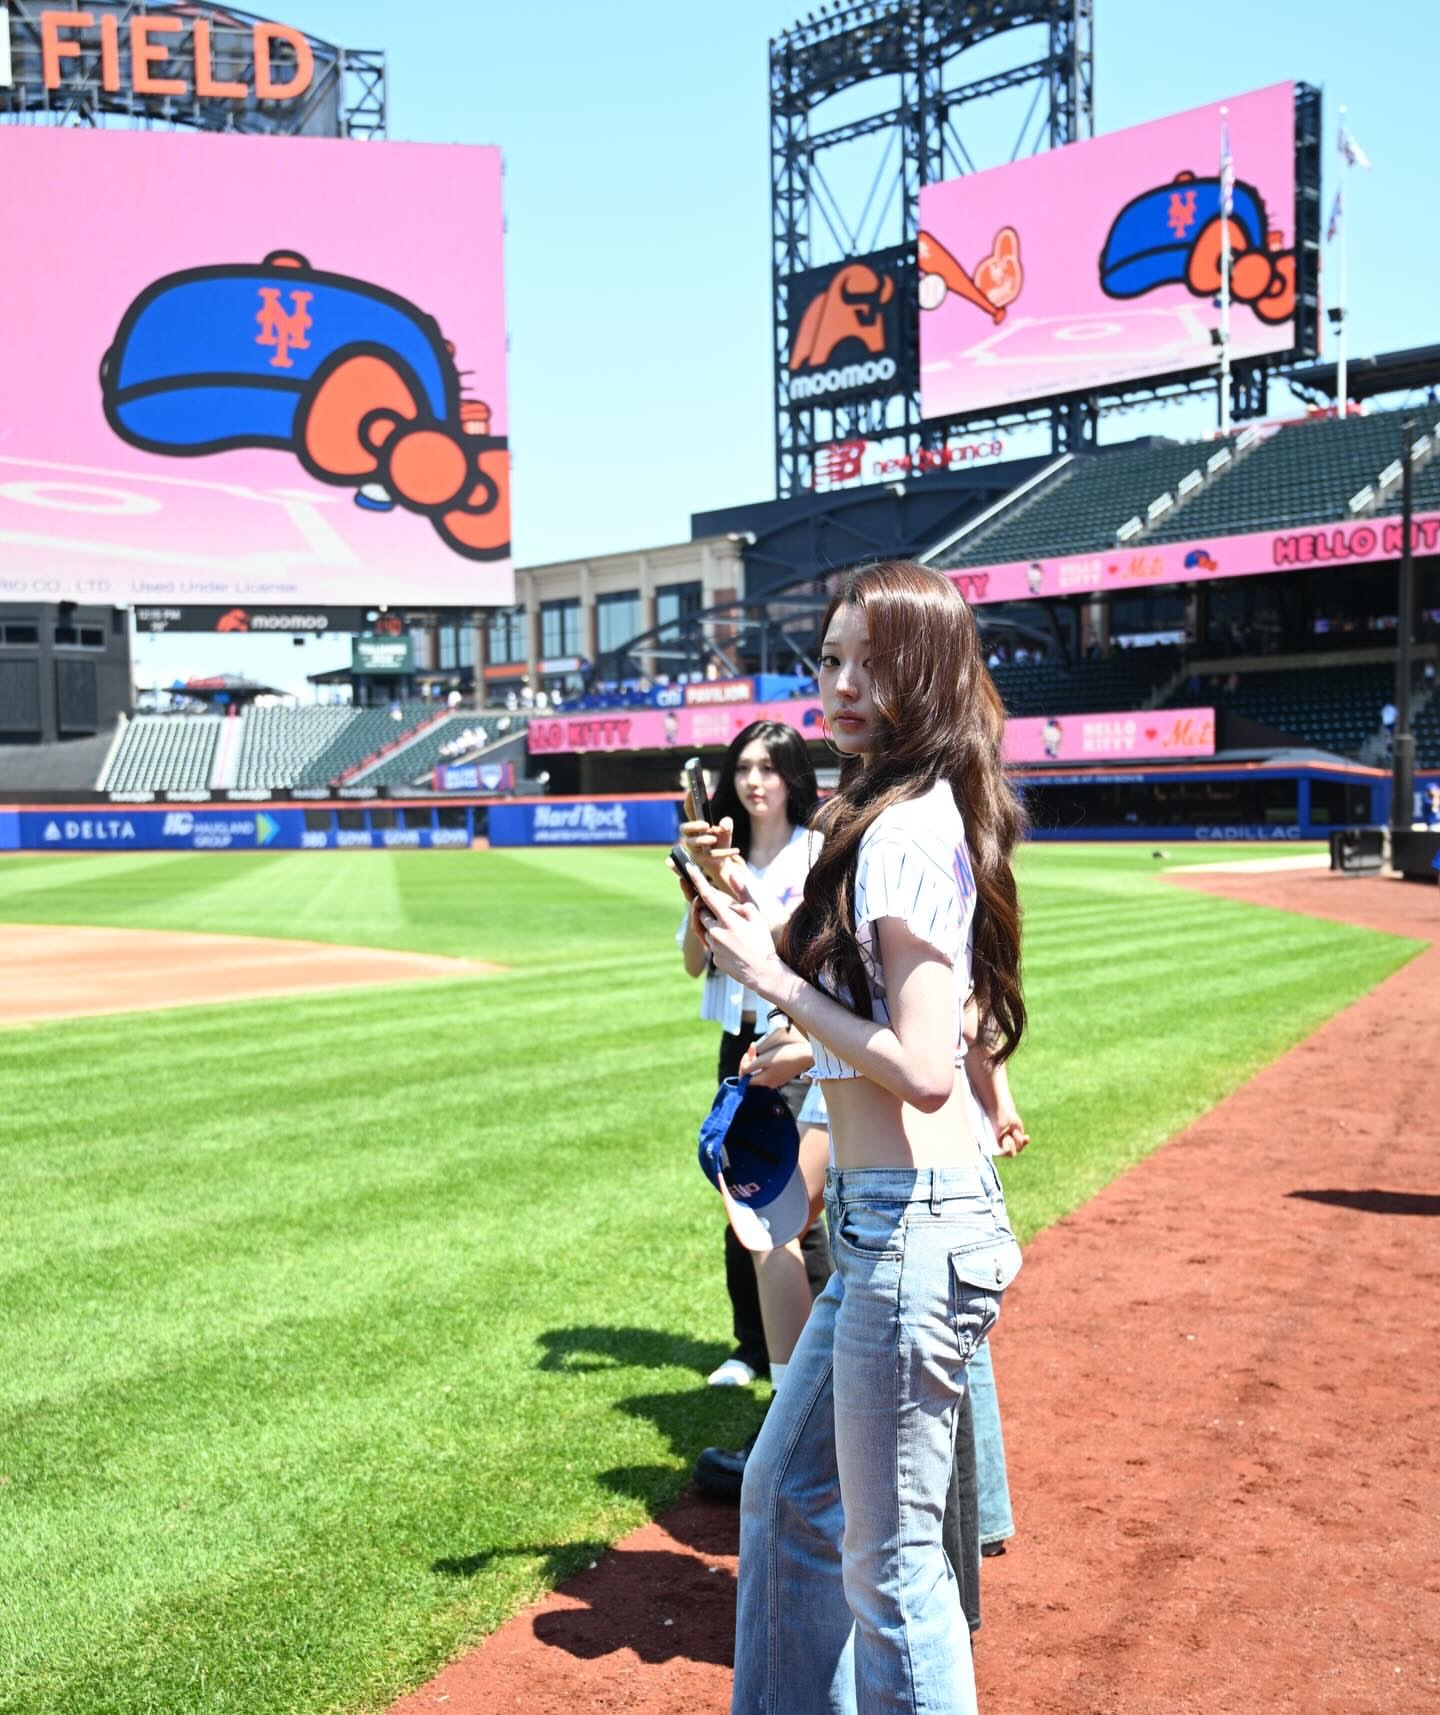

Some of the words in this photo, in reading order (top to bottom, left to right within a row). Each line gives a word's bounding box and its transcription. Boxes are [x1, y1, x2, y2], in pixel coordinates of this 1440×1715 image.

[41, 11, 314, 99] FIELD
[789, 357, 897, 400] moomoo
[1273, 527, 1377, 565] HELLO
[1059, 559, 1101, 576] HELLO
[131, 578, 174, 593] Used
[181, 577, 229, 593] Under
[1059, 572, 1101, 588] KITTY
[252, 614, 328, 630] moomoo
[568, 719, 632, 747] KITTY
[1083, 719, 1136, 737] HELLO
[1083, 737, 1136, 752] KITTY
[534, 804, 581, 828] Hard
[581, 803, 627, 831] Rock
[65, 820, 136, 840] DELTA
[1195, 825, 1301, 840] CADILLAC
